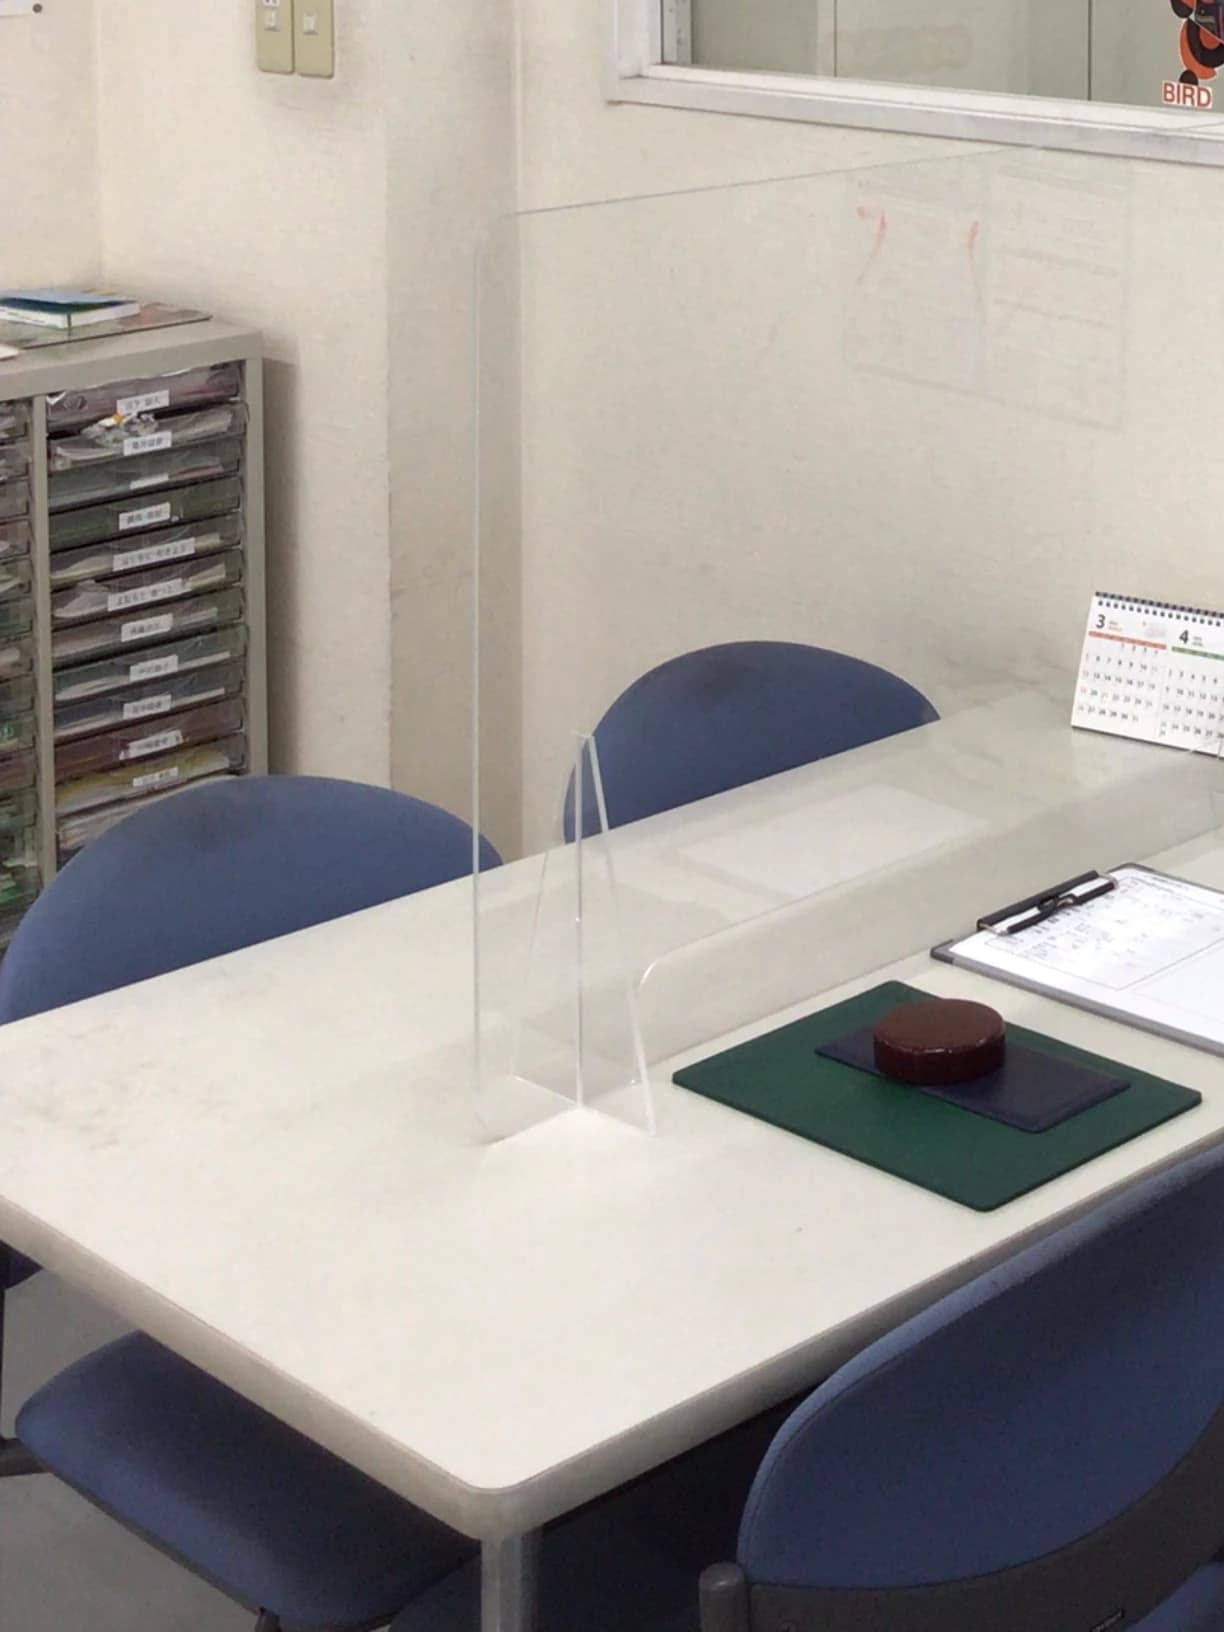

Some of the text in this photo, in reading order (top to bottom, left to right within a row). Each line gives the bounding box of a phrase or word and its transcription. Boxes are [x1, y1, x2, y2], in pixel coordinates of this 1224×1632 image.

[1163, 82, 1212, 107] BIRD
[1096, 614, 1106, 629] 3
[1179, 630, 1189, 644] 4
